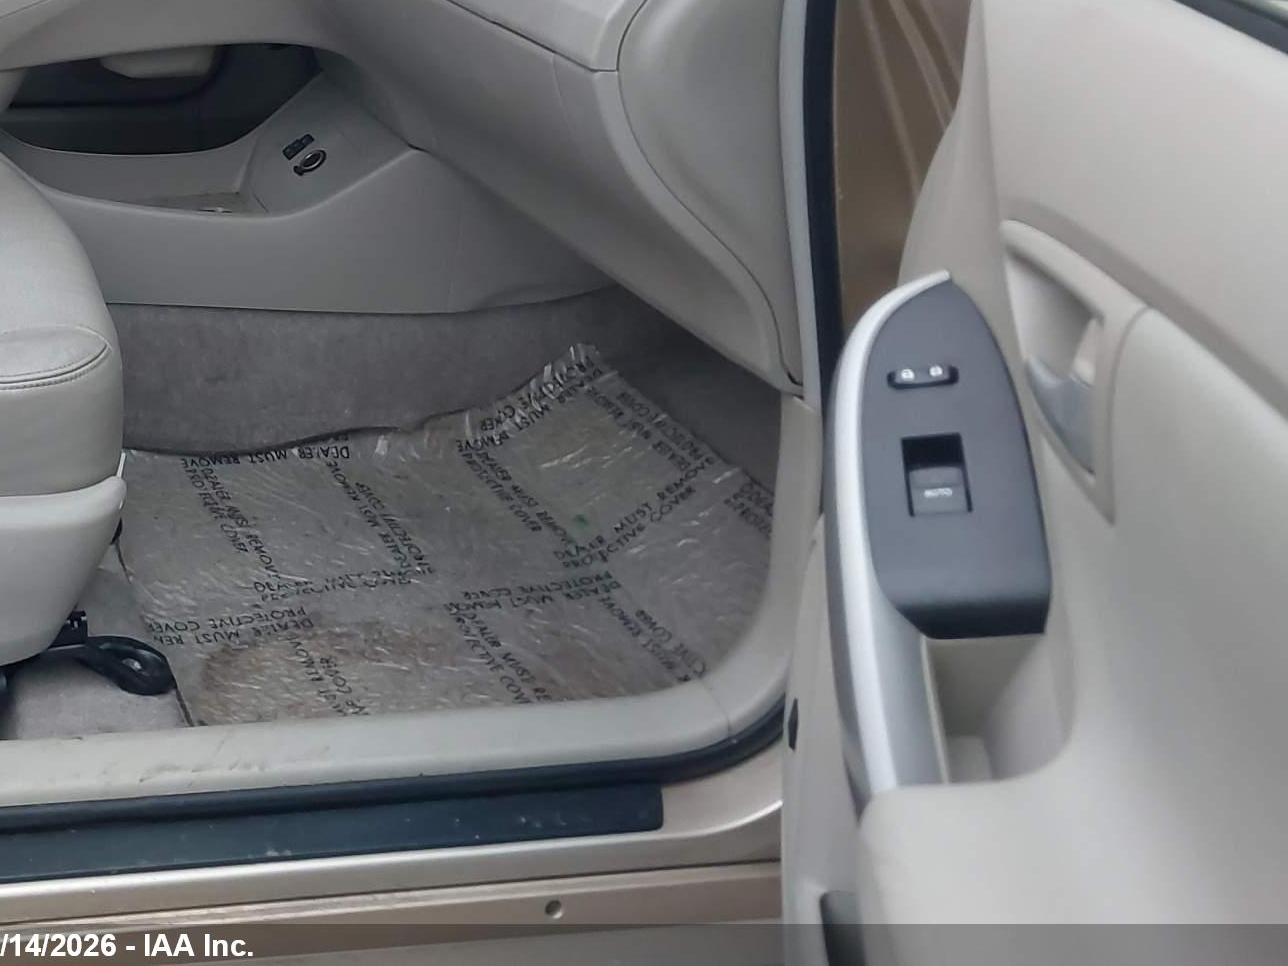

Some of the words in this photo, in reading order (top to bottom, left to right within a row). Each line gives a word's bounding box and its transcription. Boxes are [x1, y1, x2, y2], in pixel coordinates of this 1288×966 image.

[514, 403, 551, 432] MUST
[248, 449, 288, 464] MUST
[299, 445, 350, 460] DEALER
[181, 455, 241, 469] REMOVE
[613, 502, 653, 533] MUST
[656, 455, 715, 501] REMOVE
[649, 485, 697, 523] COVER
[209, 606, 307, 630] PROTECTIVE
[147, 620, 201, 633] COVER
[196, 630, 241, 645] MUST
